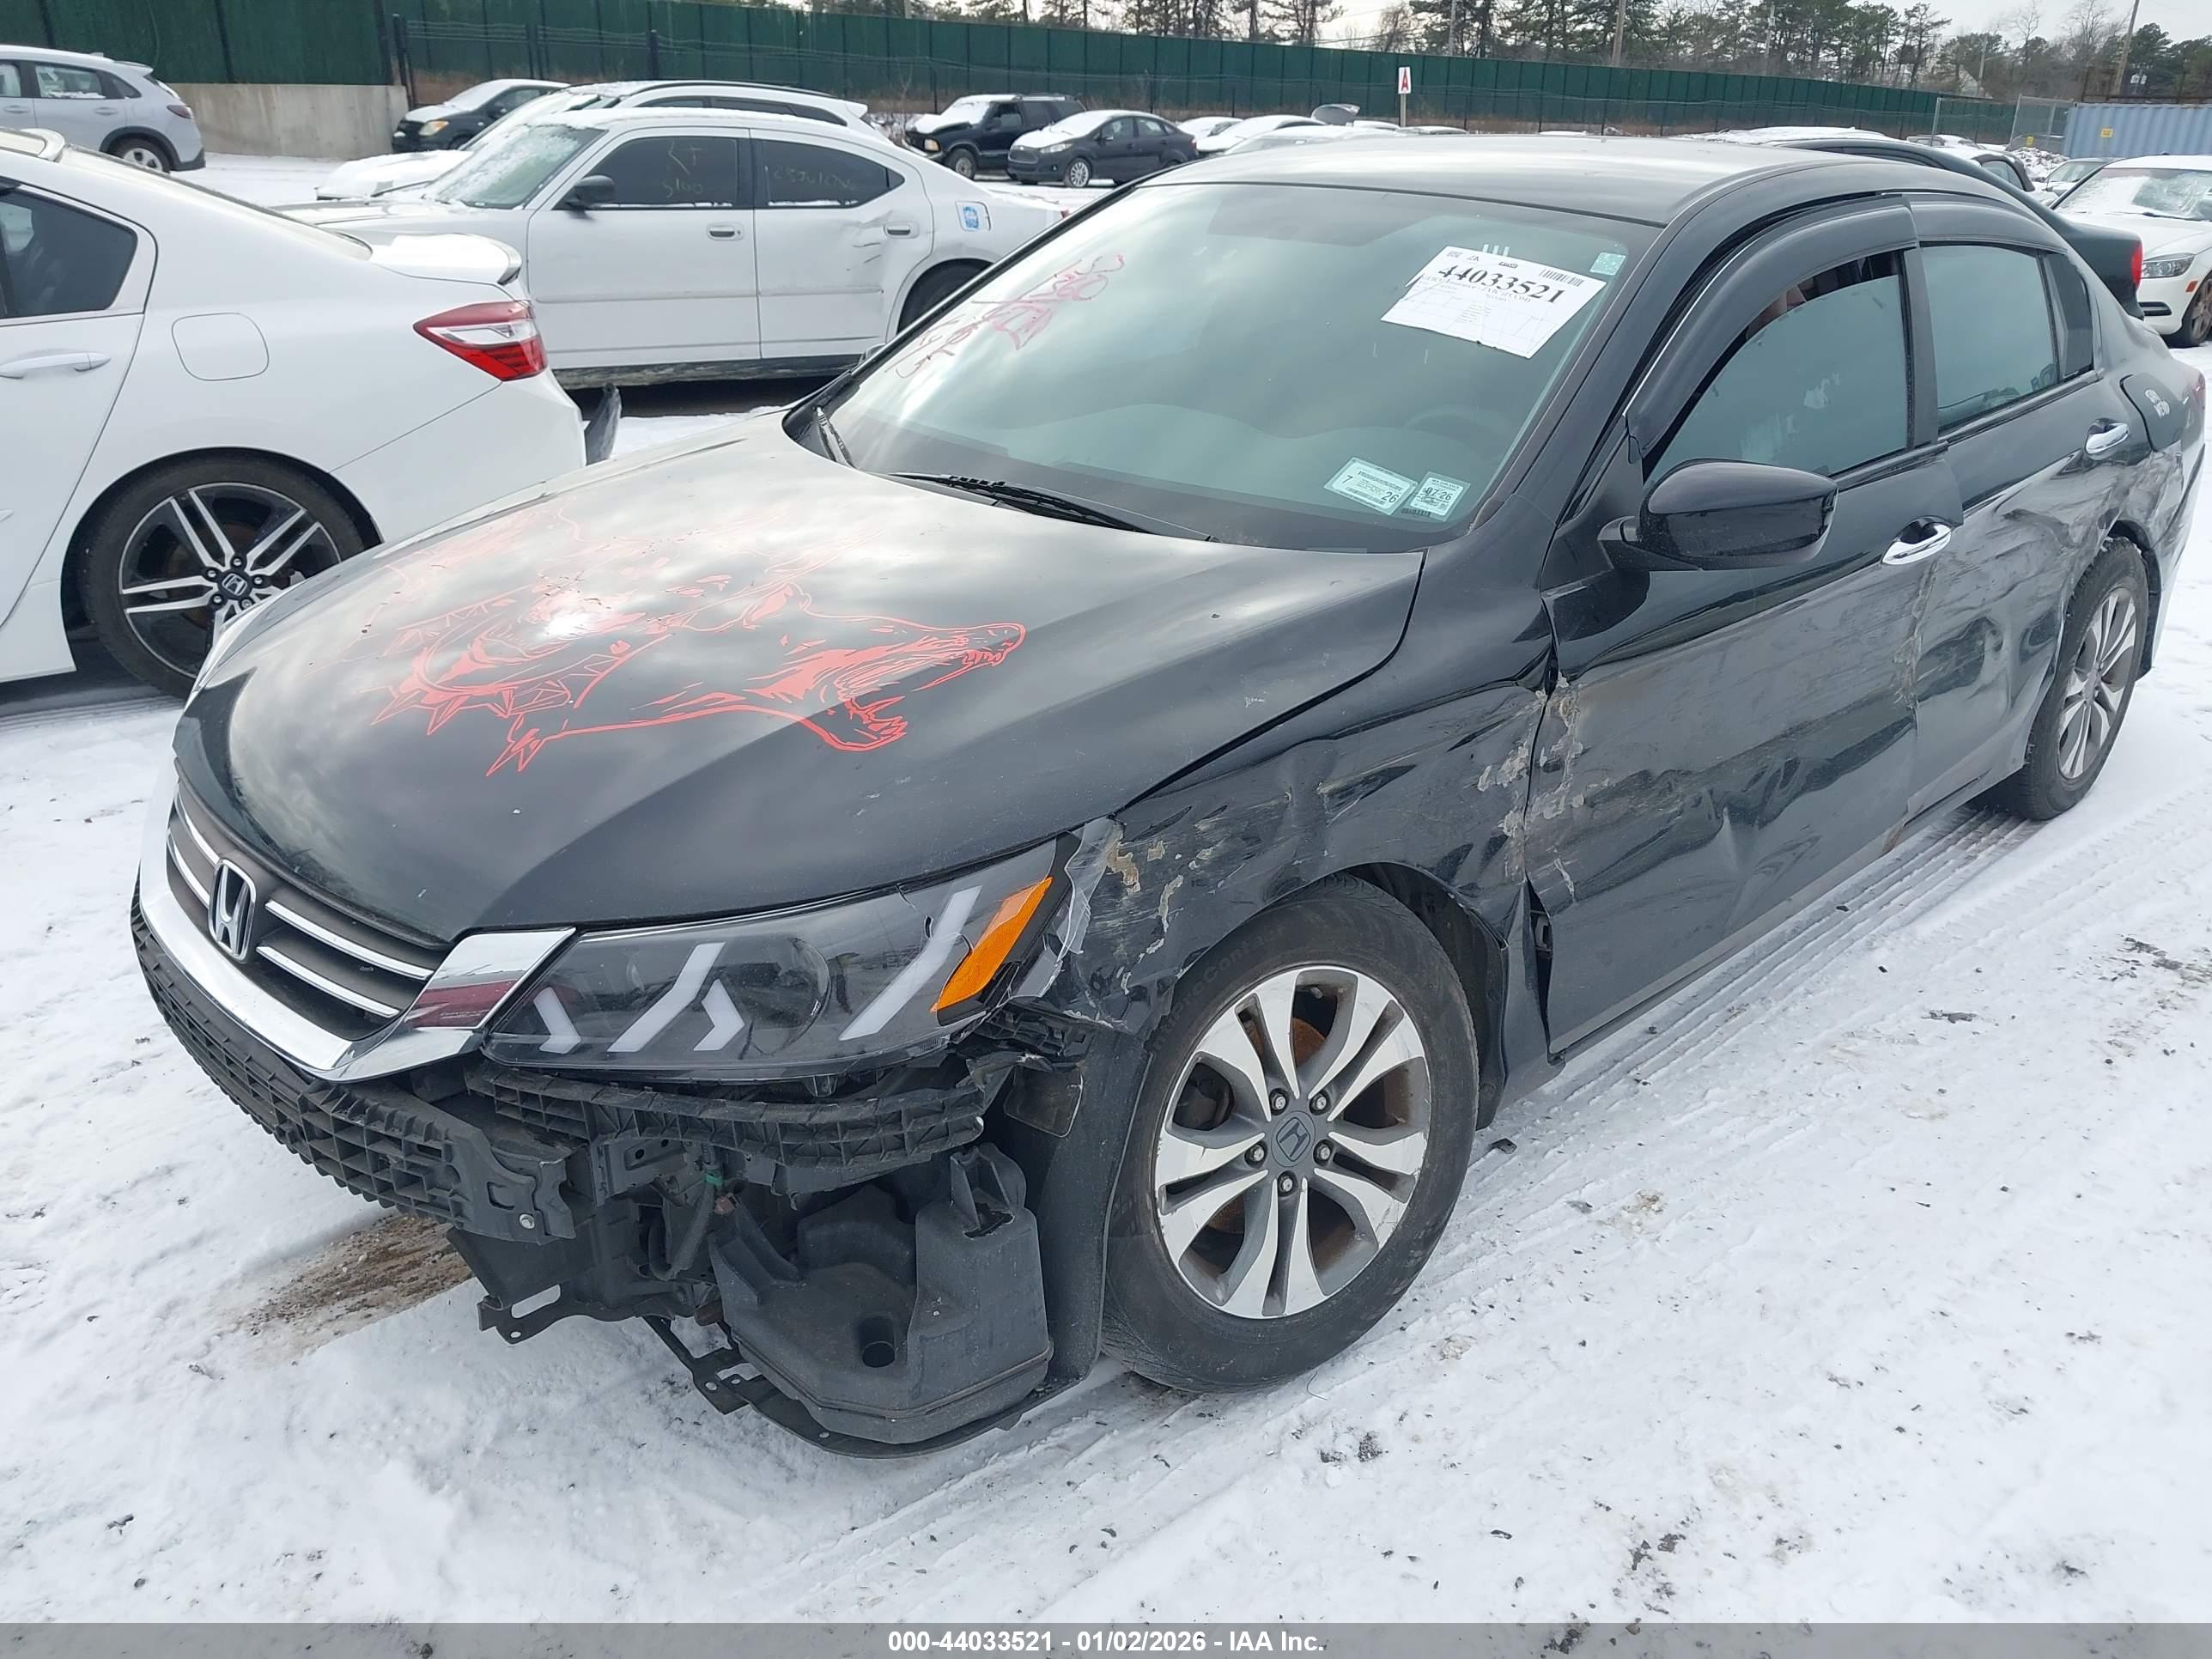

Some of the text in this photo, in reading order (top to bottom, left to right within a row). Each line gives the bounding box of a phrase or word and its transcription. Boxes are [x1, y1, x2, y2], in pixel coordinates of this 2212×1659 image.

[1401, 69, 1408, 91] A
[1437, 264, 1565, 303] 44033521
[1381, 490, 1400, 503] 26
